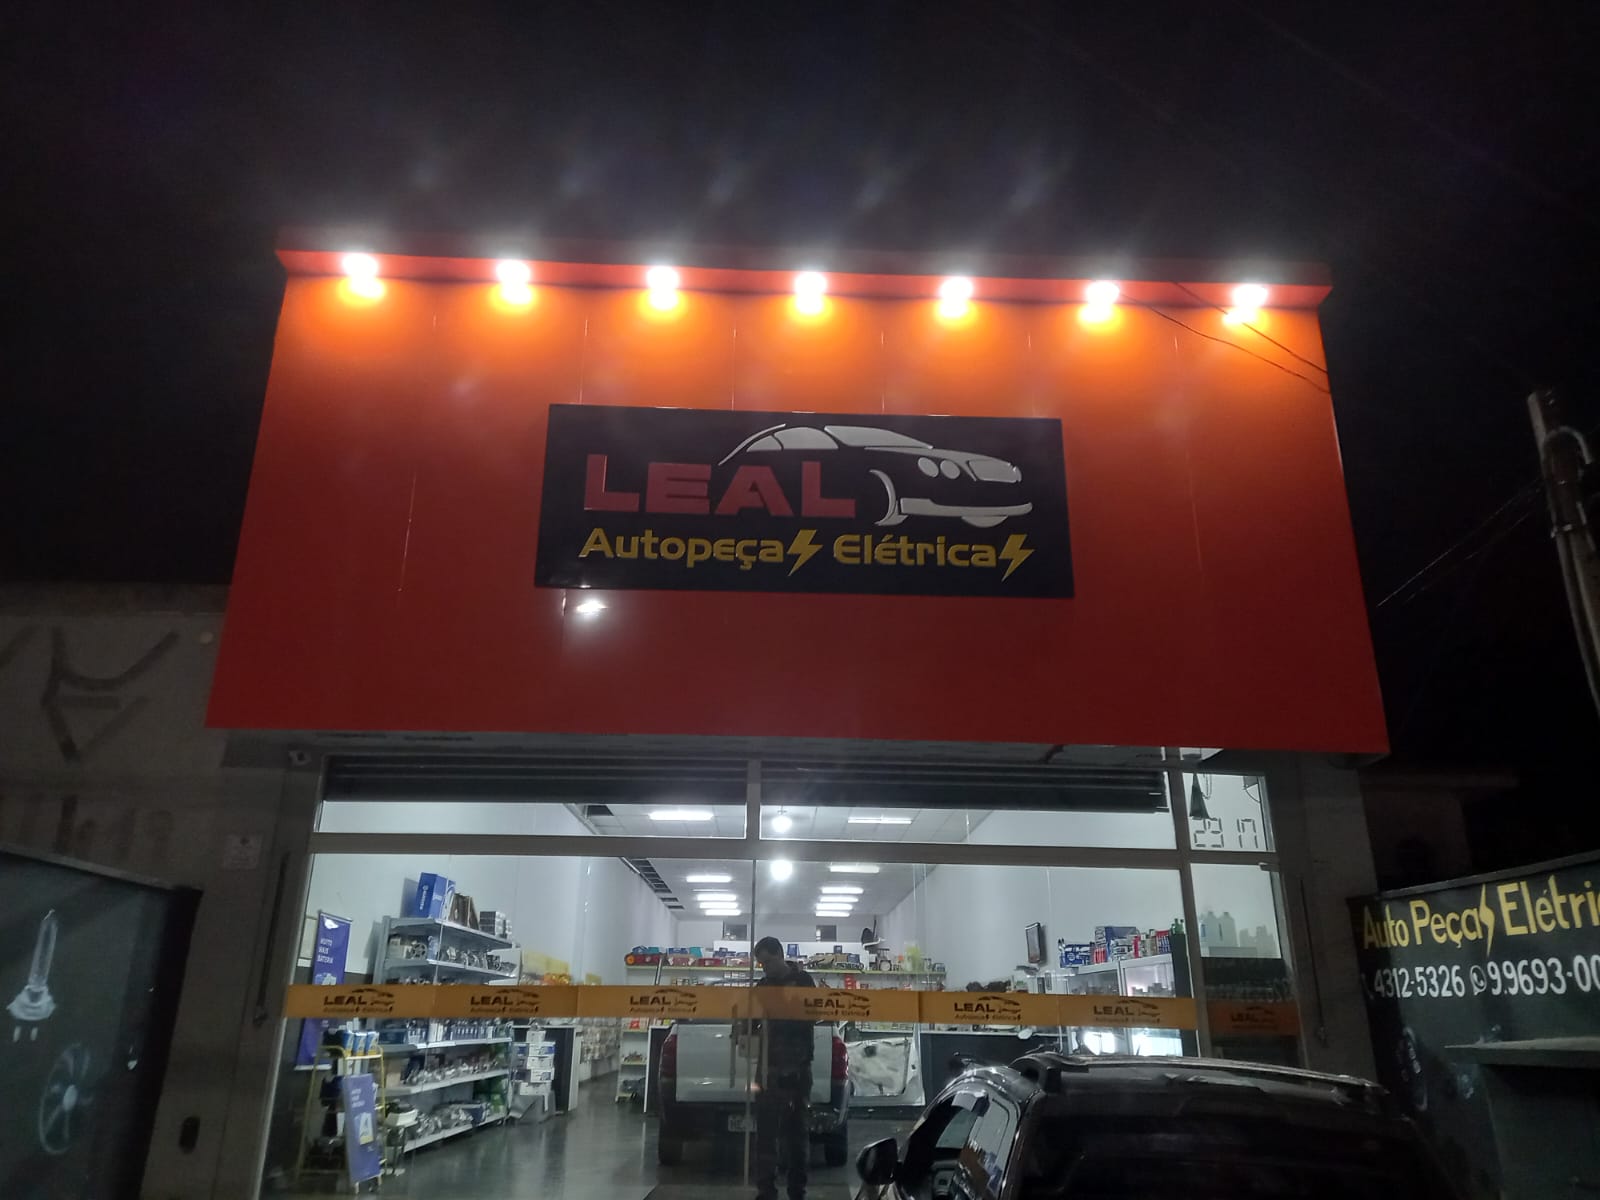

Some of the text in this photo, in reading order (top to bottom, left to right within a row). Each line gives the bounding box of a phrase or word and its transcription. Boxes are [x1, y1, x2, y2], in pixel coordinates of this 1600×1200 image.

[583, 453, 856, 518] LEAL
[1363, 903, 1410, 949] Auto
[1496, 874, 1600, 936] Elétri
[1374, 964, 1466, 998] 4312-5326
[324, 995, 367, 1005] LEAL
[470, 996, 513, 1005] LEAL
[630, 996, 671, 1005] LEAL
[804, 998, 845, 1008] LEAL
[954, 1002, 996, 1012] LEAL
[1094, 1005, 1135, 1015] LEAL
